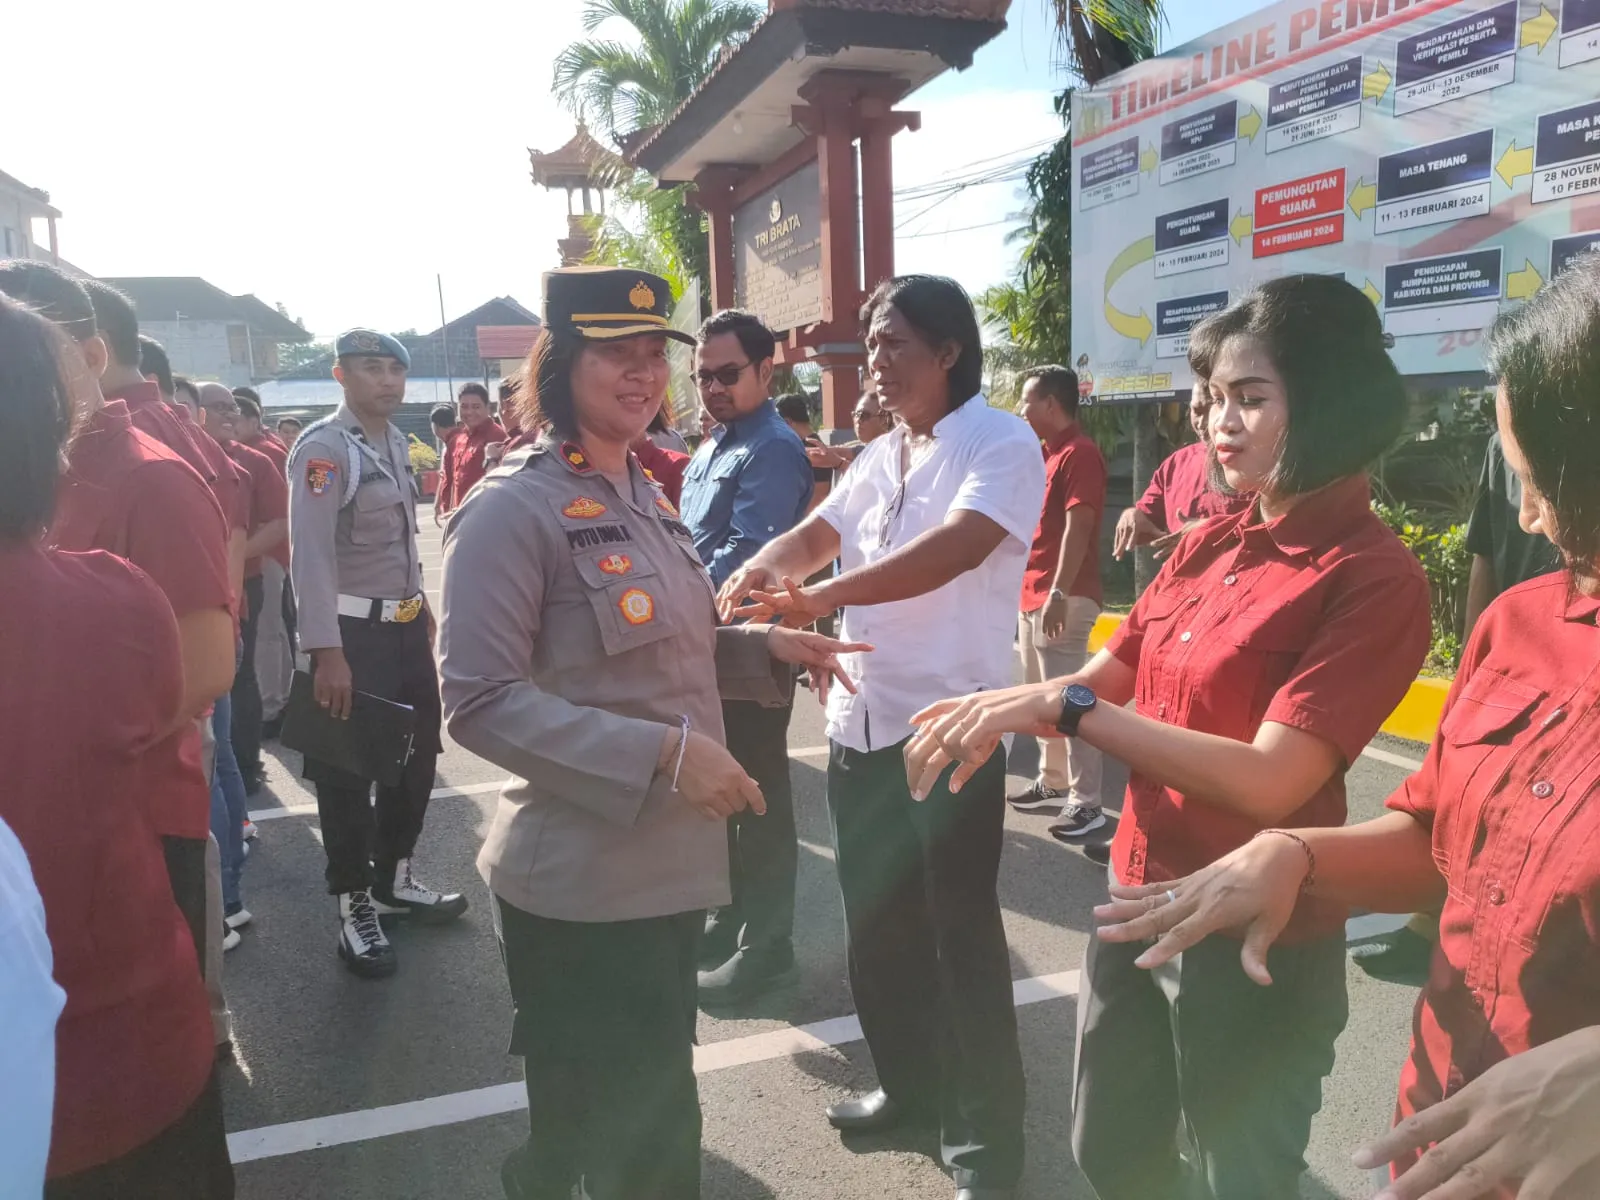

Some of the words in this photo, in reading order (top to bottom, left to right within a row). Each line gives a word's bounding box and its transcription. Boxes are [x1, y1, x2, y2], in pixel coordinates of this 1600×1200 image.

[1416, 24, 1475, 51] PENDAFTARAN
[1476, 17, 1495, 30] DAN
[1413, 41, 1457, 62] VERIFIKASI
[1459, 27, 1497, 46] PESERTA
[1438, 47, 1468, 64] PEMILU
[1108, 22, 1277, 120] TIMELINE
[1331, 64, 1349, 76] DATA
[1418, 83, 1435, 94] JULI
[1454, 64, 1500, 83] DESEMBER
[1272, 104, 1284, 114] DAN
[1330, 80, 1356, 94] DAFTAR
[1557, 117, 1590, 135] MASA
[1399, 165, 1425, 178] MASA
[1427, 154, 1468, 172] TENANG
[1544, 172, 1557, 182] 28
[1261, 176, 1337, 205] PEMUNGUTAN
[1552, 185, 1564, 194] 10
[1280, 198, 1316, 216] SUARA
[1381, 212, 1390, 222] 11
[1398, 209, 1409, 219] 13
[1411, 199, 1458, 216] FEBRUARI
[1460, 194, 1484, 207] 2024
[754, 232, 769, 249] TRI
[770, 213, 801, 241] BRATA
[1180, 224, 1200, 236] SUARA
[1261, 238, 1271, 247] 14
[1272, 229, 1312, 245] FEBRUARI
[1314, 224, 1334, 237] 2024
[1178, 252, 1207, 264] FEBRUARI
[1414, 262, 1467, 277] PENGUCAPAN
[1460, 270, 1481, 280] DPRD
[1433, 285, 1449, 294] DAN
[1451, 280, 1489, 292] PROVINSI
